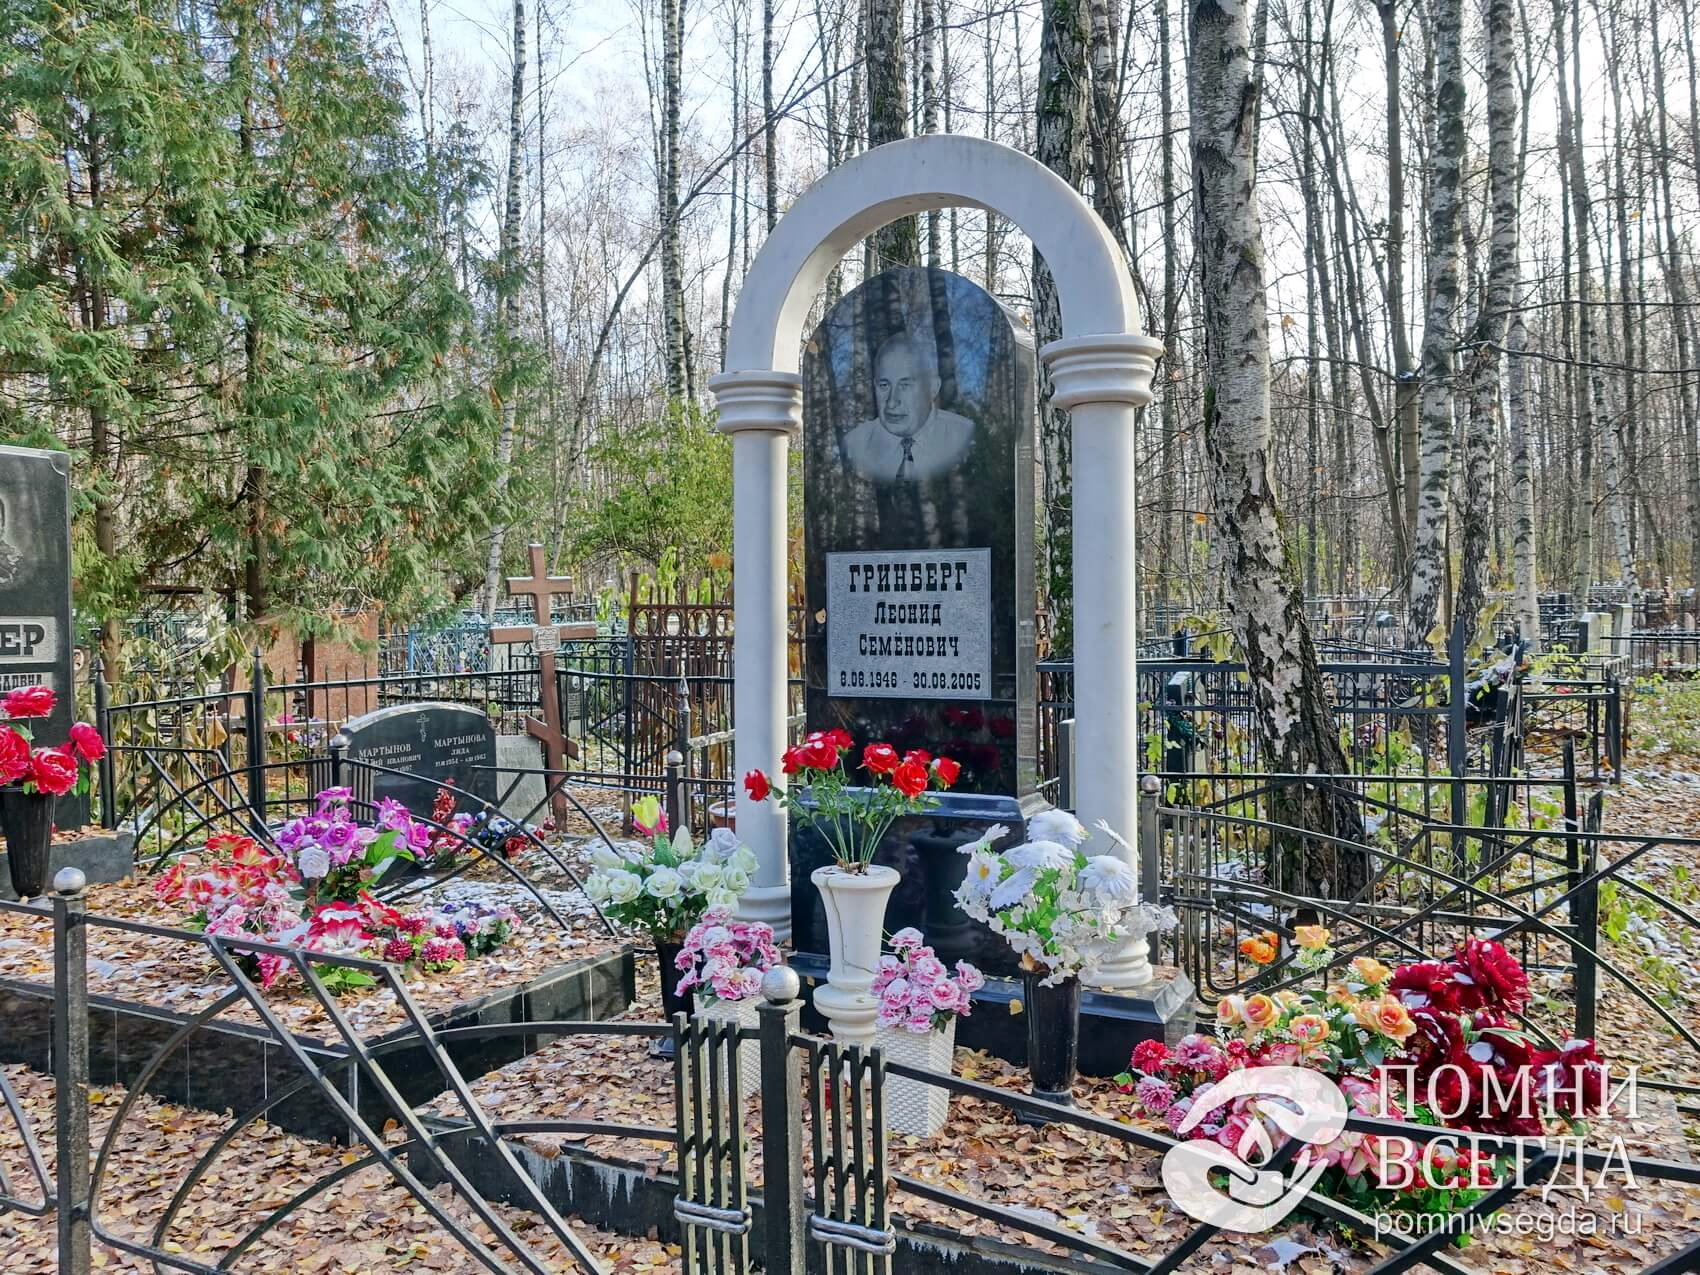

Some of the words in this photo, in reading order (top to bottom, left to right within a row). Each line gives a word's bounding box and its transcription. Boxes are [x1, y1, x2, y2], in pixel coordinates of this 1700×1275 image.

[849, 562, 967, 592] ГРИНБЕРГ
[840, 671, 897, 688] 8.08.1946
[913, 671, 981, 690] 30.08.2005
[434, 734, 487, 748] МАРТЫНОВА
[359, 743, 412, 759] МАРТЫНОВ
